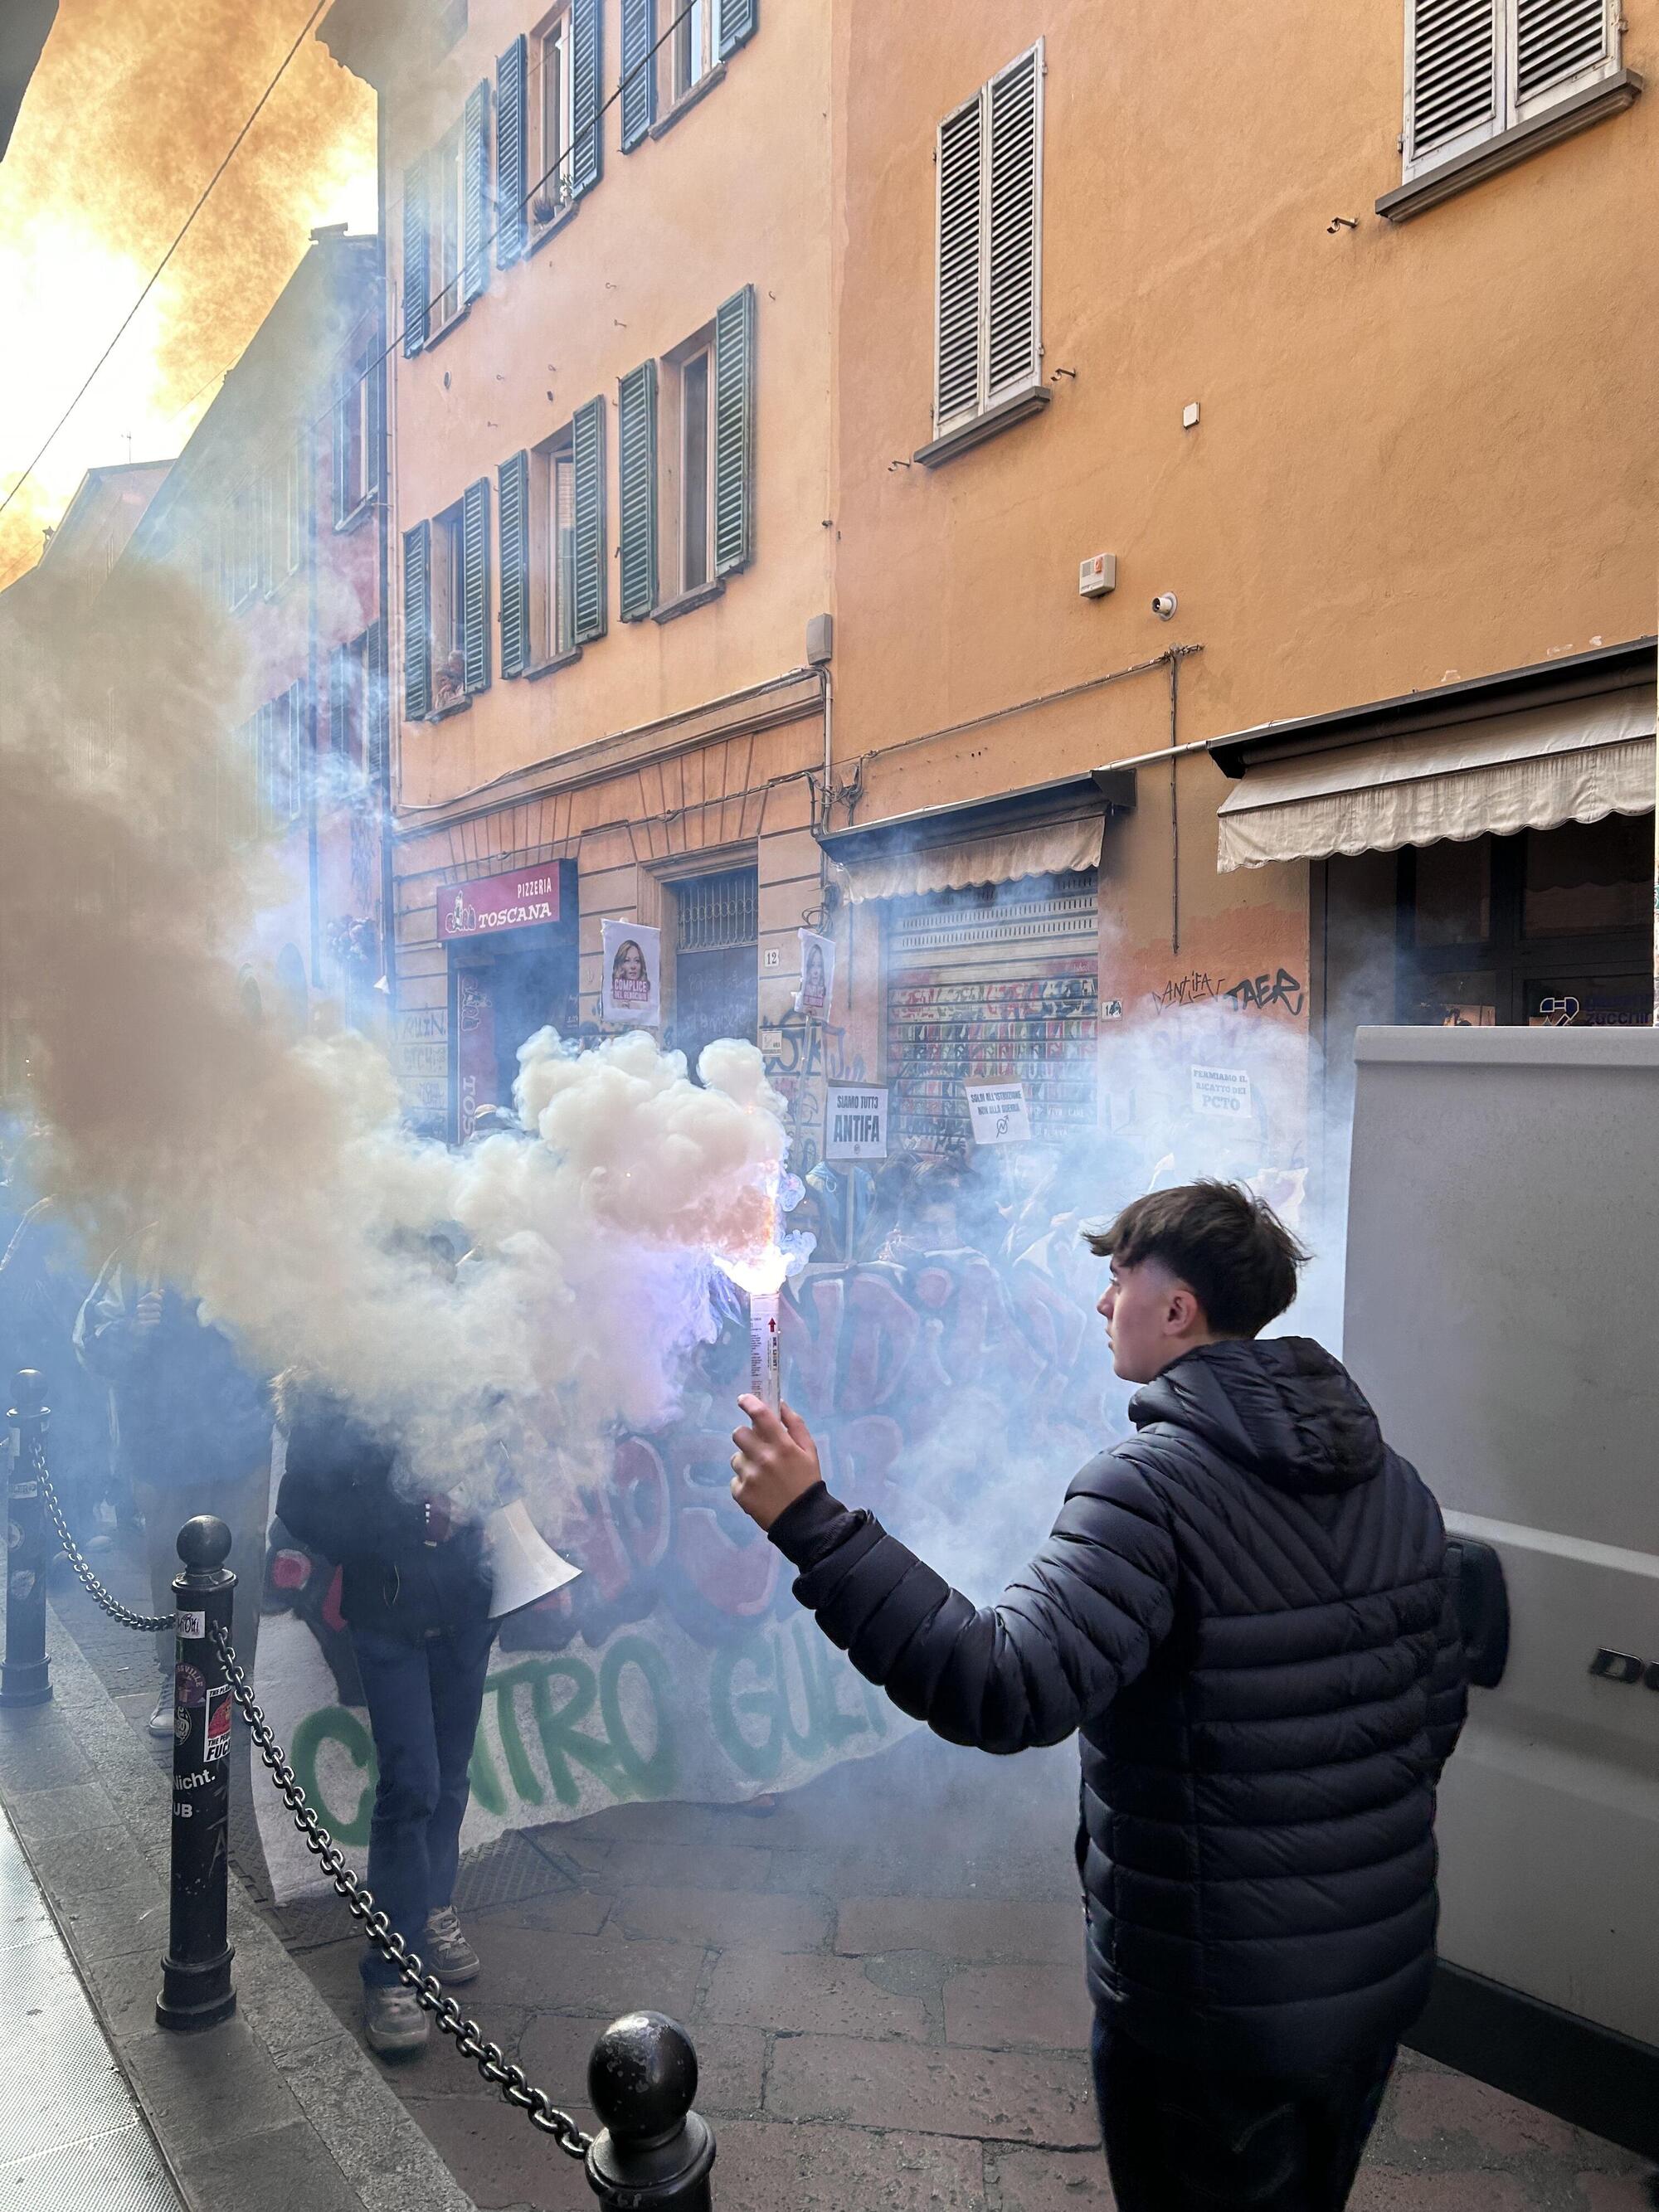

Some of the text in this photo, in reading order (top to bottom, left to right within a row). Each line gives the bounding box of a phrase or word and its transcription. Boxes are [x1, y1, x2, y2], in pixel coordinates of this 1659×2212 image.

[518, 878, 552, 898] PIZZERIA
[478, 902, 552, 929] TOSCANA
[766, 952, 777, 965] 12
[615, 979, 647, 992] COMPLICE
[1194, 1070, 1237, 1082] FERMIAMO
[1195, 1082, 1230, 1093] RICATTO
[837, 1095, 859, 1109] SIAMO
[1202, 1095, 1241, 1111] PCTO
[834, 1115, 880, 1142] ANTIFA
[207, 1738, 219, 1747] THE
[289, 1633, 677, 1848] CTRO
[173, 1769, 216, 1791] Nicht.
